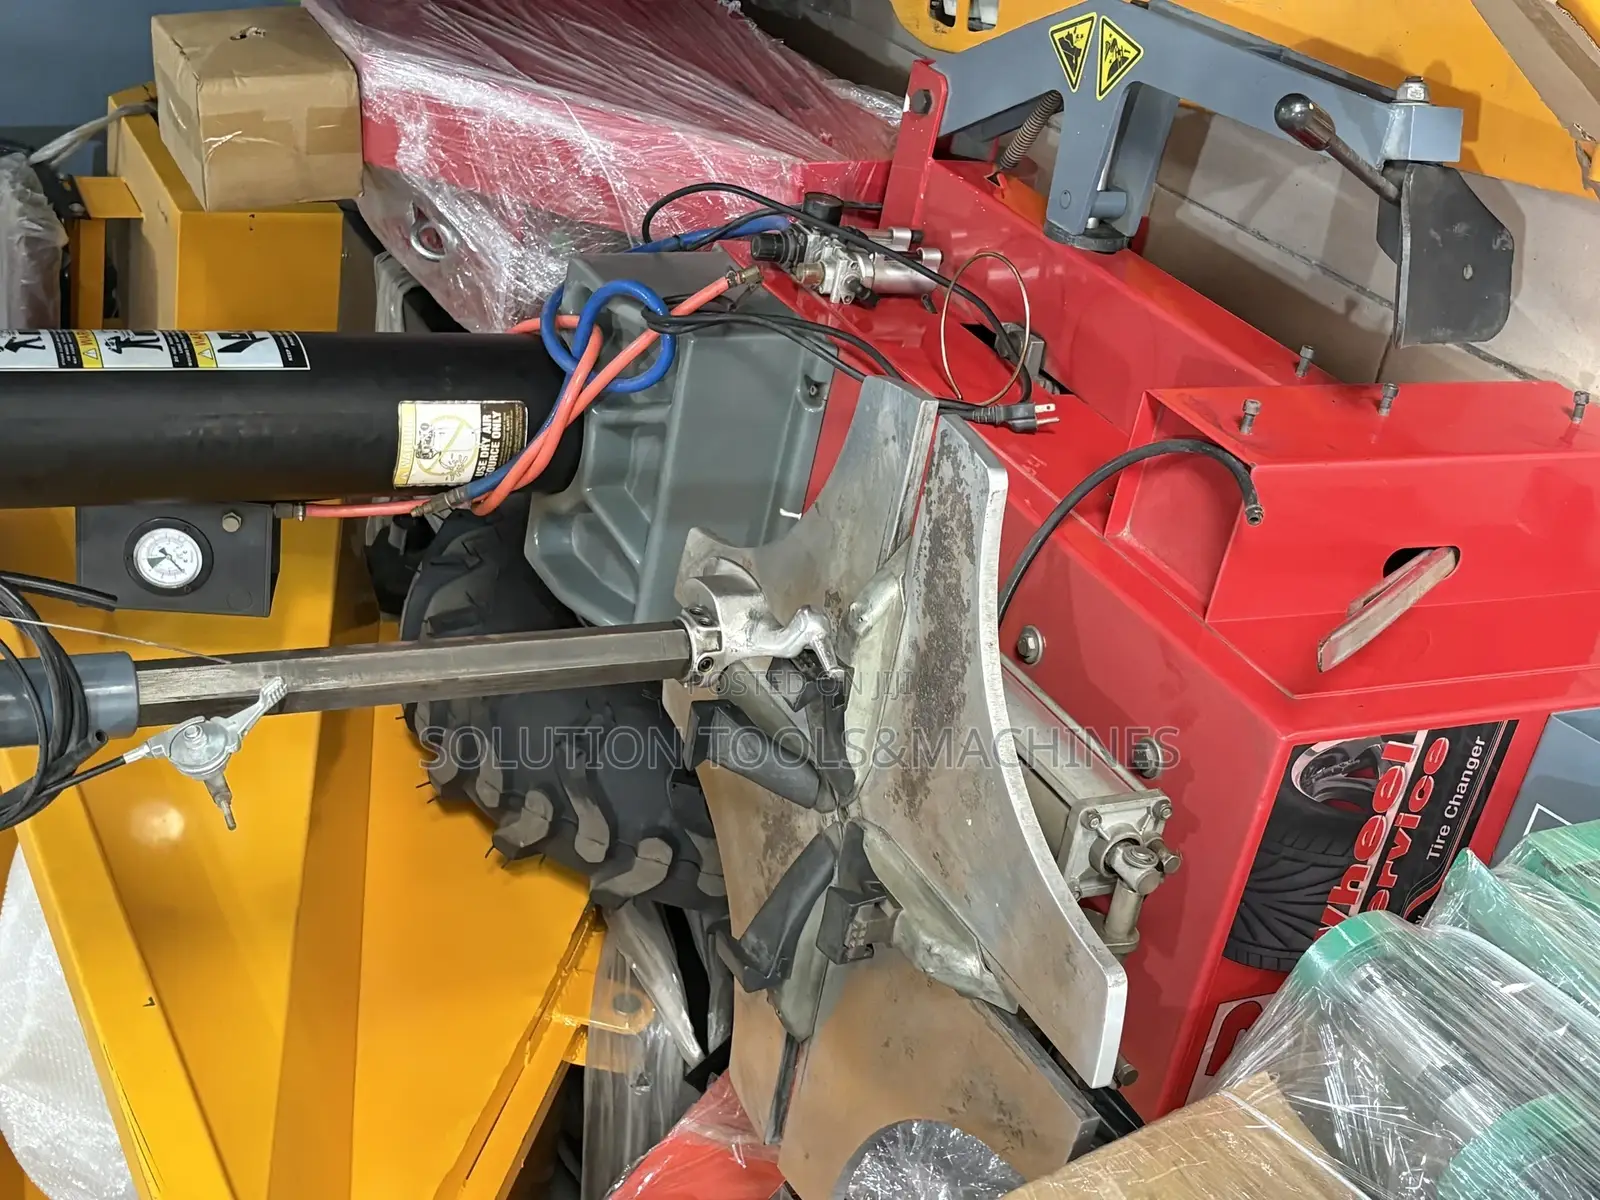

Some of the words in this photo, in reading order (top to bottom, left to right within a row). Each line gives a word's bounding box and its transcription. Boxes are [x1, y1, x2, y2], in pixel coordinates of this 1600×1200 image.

[482, 414, 492, 434] AIR
[491, 410, 502, 439] ONLY
[479, 436, 491, 458] DRY
[485, 441, 500, 476] OURCE
[475, 460, 487, 476] USE
[1426, 825, 1451, 861] Tire
[1444, 735, 1487, 819] Changer
[1367, 737, 1449, 911] ervice
